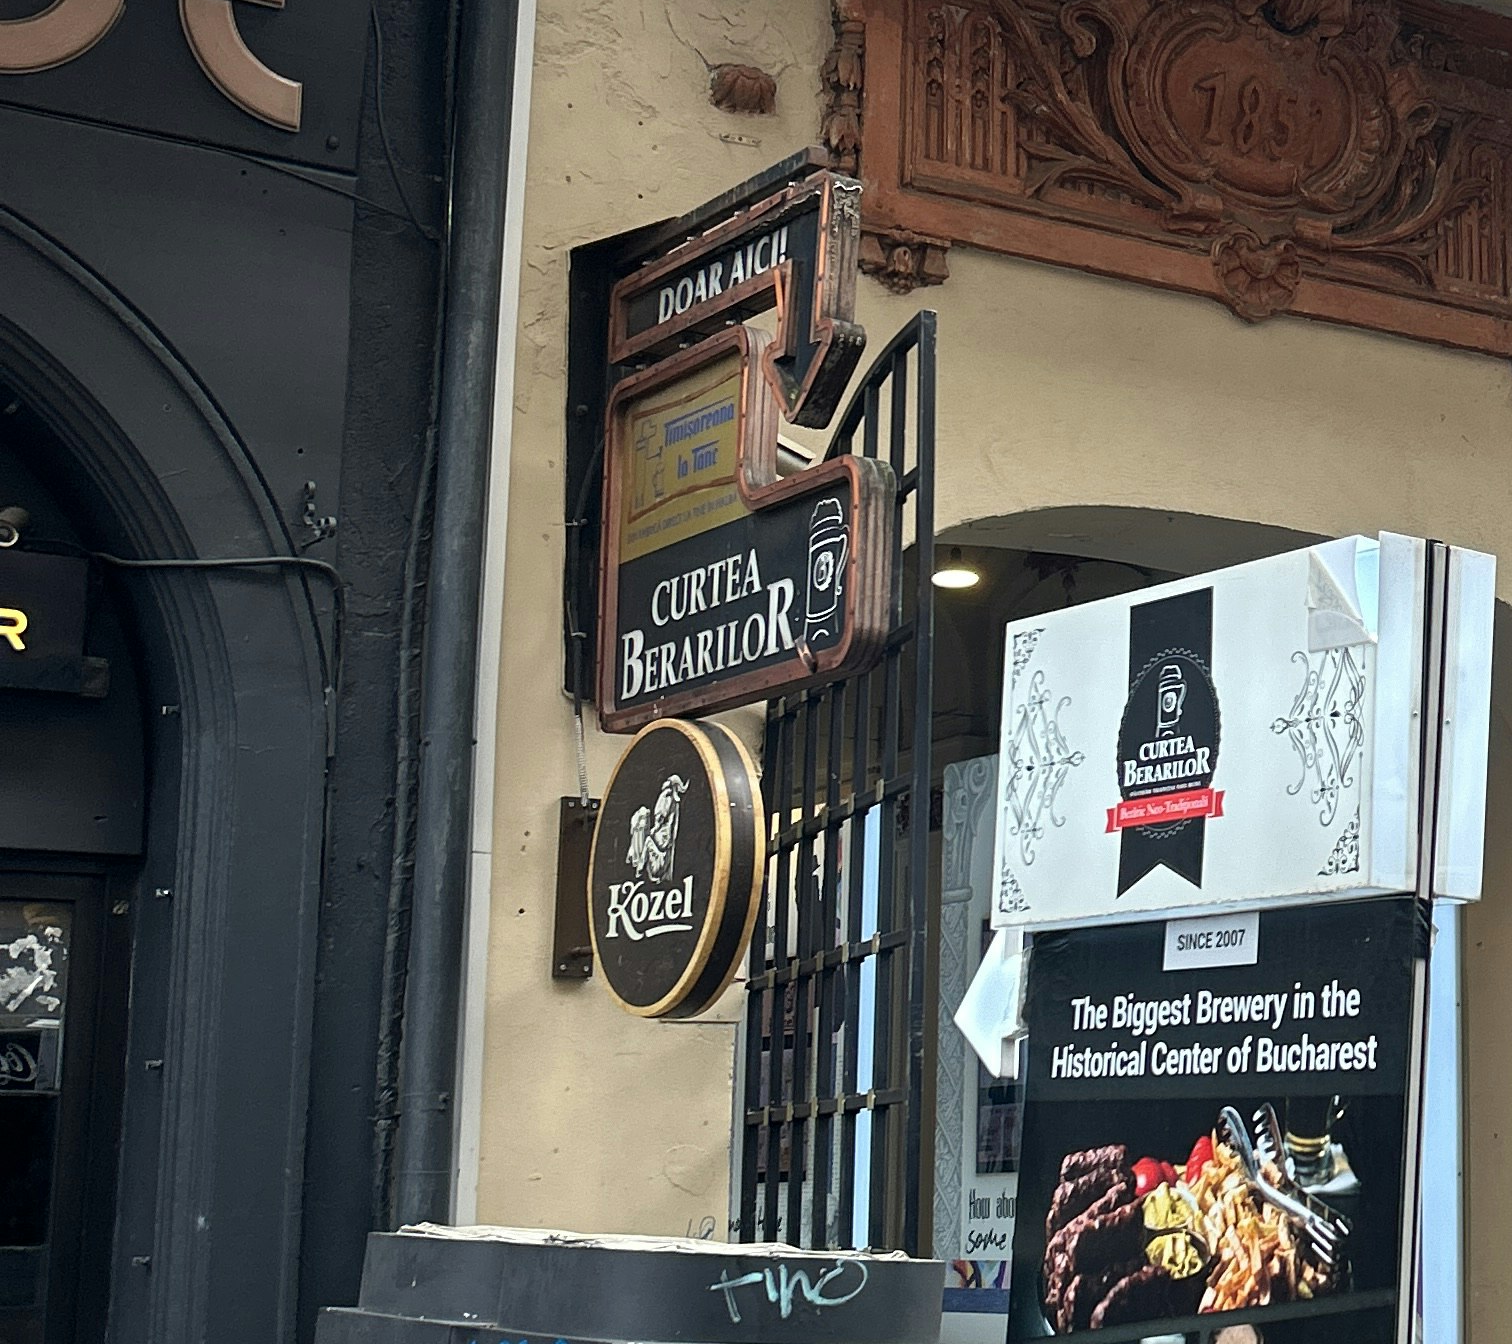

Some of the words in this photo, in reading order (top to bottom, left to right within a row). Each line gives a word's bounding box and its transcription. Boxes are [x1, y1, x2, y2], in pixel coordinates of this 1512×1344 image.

[658, 262, 723, 324] DOAR
[728, 226, 788, 289] AICI!
[652, 548, 762, 626] CURTEA
[621, 578, 795, 700] BERARILOR
[1123, 747, 1211, 787] BERARILOR
[1139, 735, 1196, 761] CURTEA
[605, 875, 693, 941] Kozel
[1177, 931, 1213, 952] SINCE
[1216, 929, 1246, 949] 2007
[1071, 995, 1108, 1031] The
[1112, 992, 1191, 1036] Biggest
[1196, 989, 1288, 1030] Brewery
[1293, 982, 1315, 1020] in
[1321, 979, 1361, 1018] the
[1051, 1040, 1147, 1079] Historical
[1151, 1041, 1222, 1076] Center
[1227, 1036, 1252, 1073] of
[1256, 1033, 1378, 1072] Bucharest
